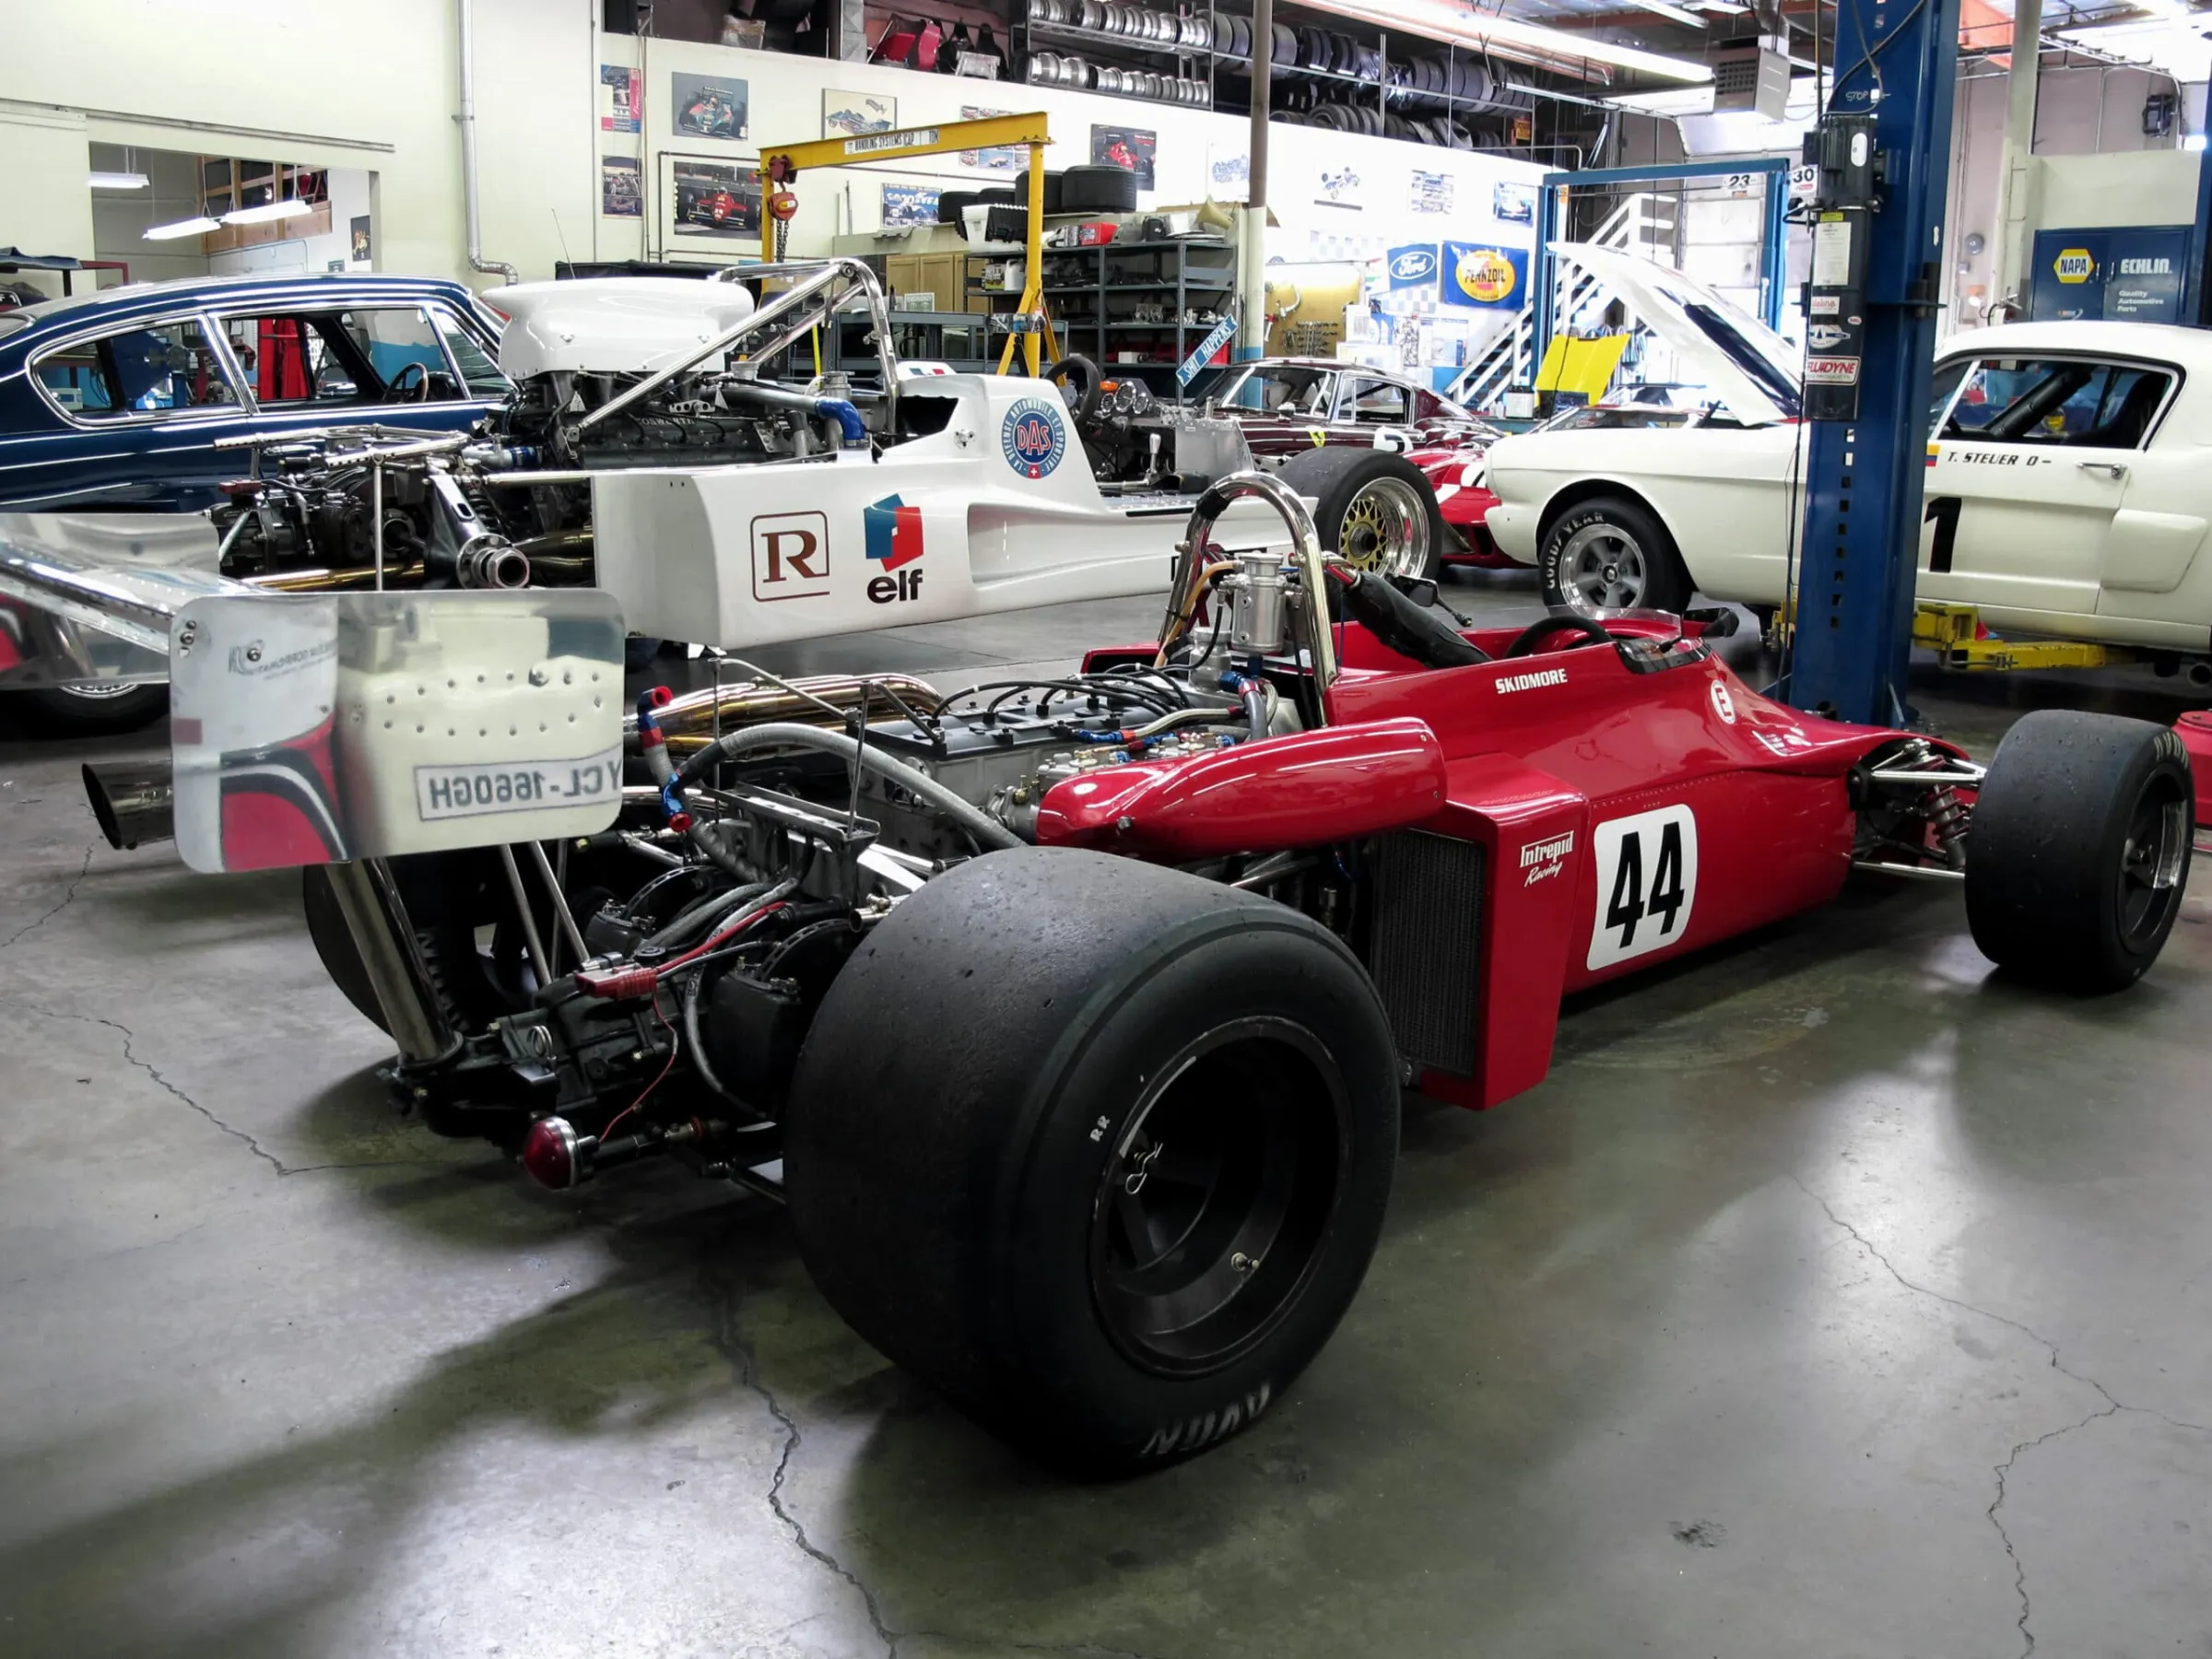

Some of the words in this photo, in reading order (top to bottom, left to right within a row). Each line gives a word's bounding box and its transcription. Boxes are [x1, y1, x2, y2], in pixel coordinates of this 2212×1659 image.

[1846, 90, 1869, 101] STOP
[878, 130, 902, 147] SYSTEMS
[1729, 173, 1751, 189] 23
[1793, 168, 1815, 183] 30
[886, 192, 939, 205] GOODYEA
[1398, 255, 1428, 276] Ford
[2060, 258, 2088, 274] NAPA
[1182, 355, 1200, 378] SHIT
[1200, 321, 1231, 359] HAPPENS
[1807, 360, 1855, 374] FLUIDYNE
[1017, 420, 1052, 455] DAS
[1962, 452, 2019, 465] STEUER
[1924, 496, 1962, 573] 1
[867, 569, 923, 604] elf
[1495, 668, 1568, 694] SKIDMORE
[1520, 830, 1574, 868] Intrepid
[1524, 861, 1563, 888] Racing
[1605, 821, 1685, 949] 44
[1089, 1114, 1111, 1143] RR
